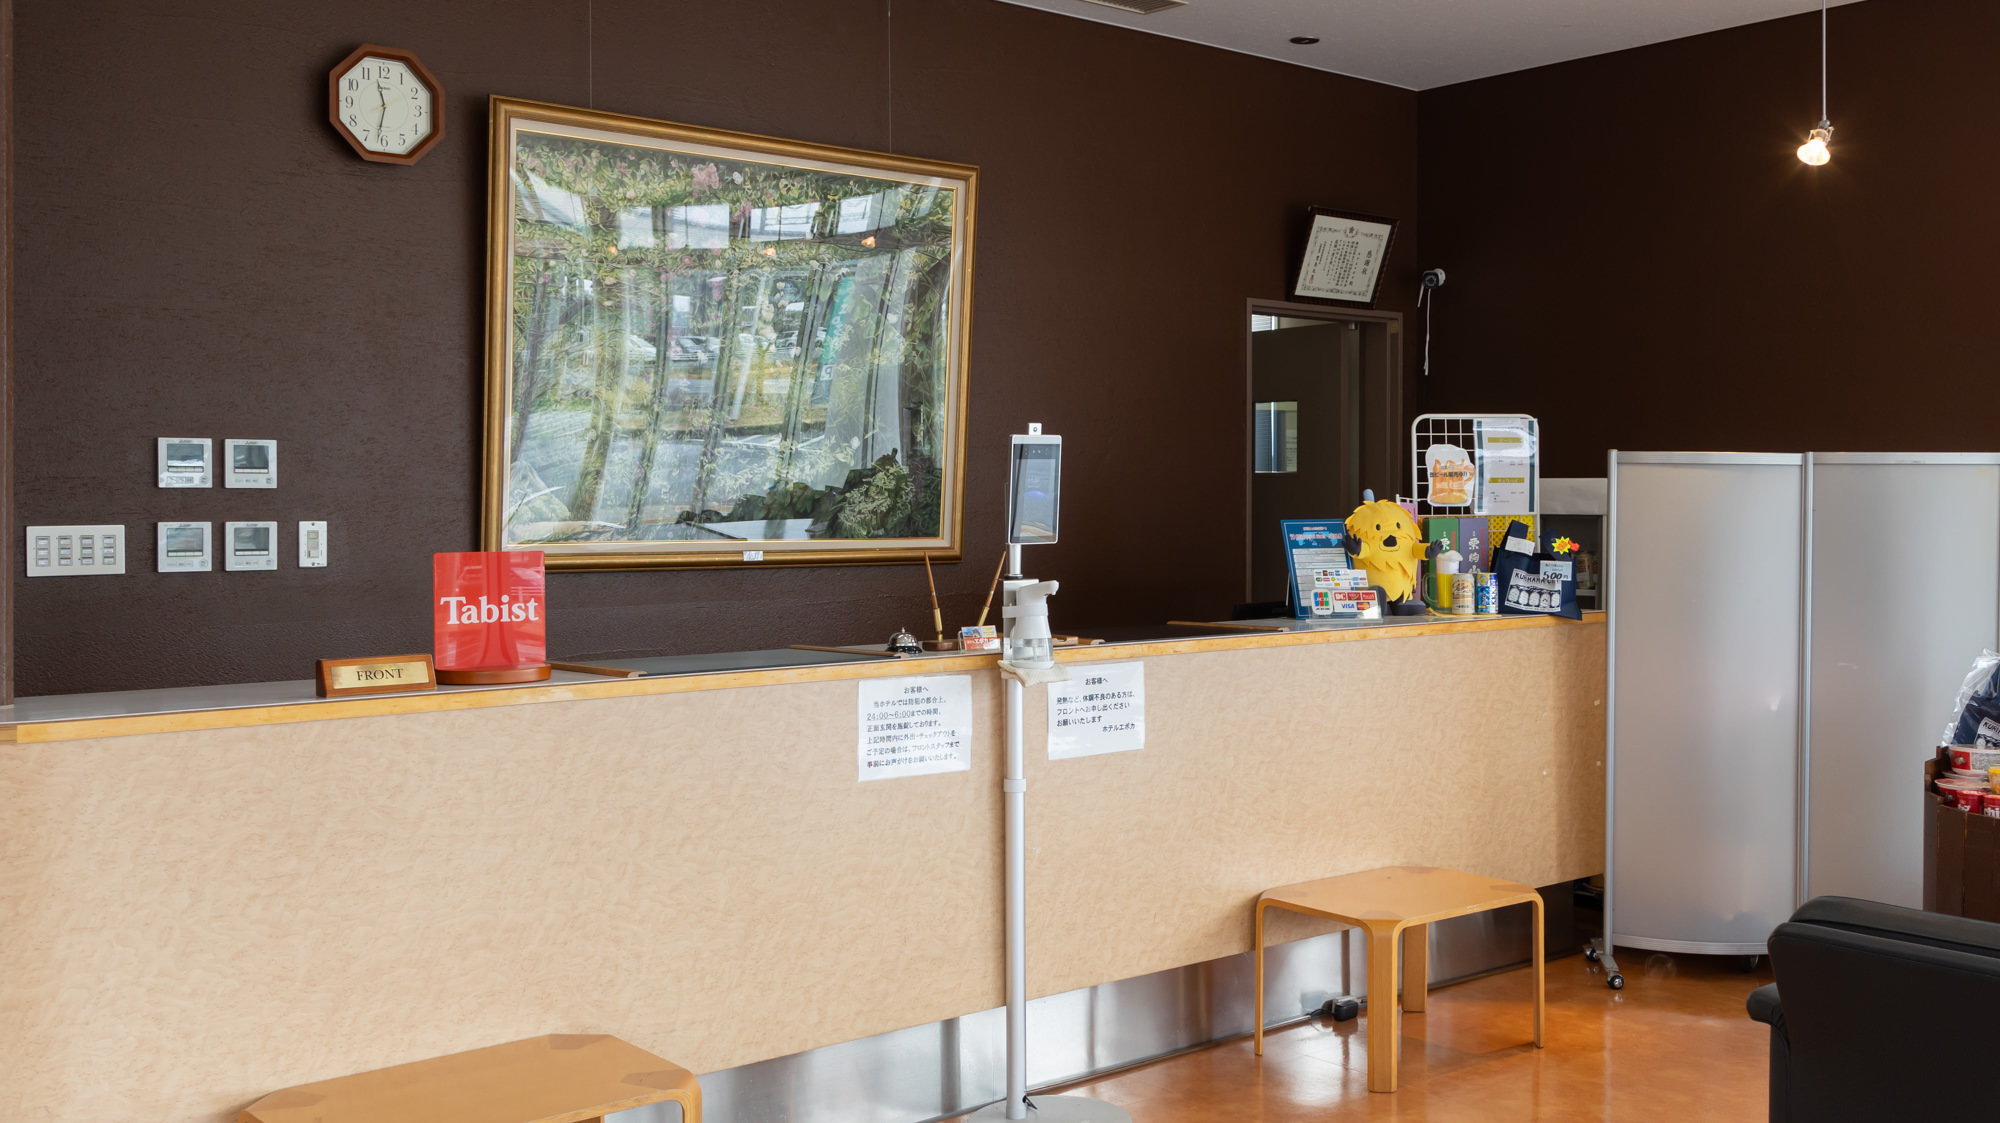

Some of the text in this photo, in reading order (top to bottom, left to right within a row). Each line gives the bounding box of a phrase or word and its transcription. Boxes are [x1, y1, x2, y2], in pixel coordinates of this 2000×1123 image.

[362, 67, 370, 80] 11
[378, 66, 390, 79] 12
[348, 79, 359, 91] 10
[399, 73, 403, 85] 1
[411, 87, 418, 100] 2
[345, 96, 354, 108] 9
[414, 105, 422, 117] 3
[349, 114, 358, 127] 8
[411, 123, 418, 135] 4
[363, 129, 370, 142] 7
[381, 135, 388, 148] 6
[398, 134, 406, 146] 5
[440, 594, 539, 625] Tabist
[356, 668, 404, 681] FRONT
[1085, 677, 1108, 686] お客様へ
[903, 685, 929, 694] お客様へ
[1057, 715, 1103, 727] お願いいたします
[1102, 723, 1136, 733] ホテルエポカ
